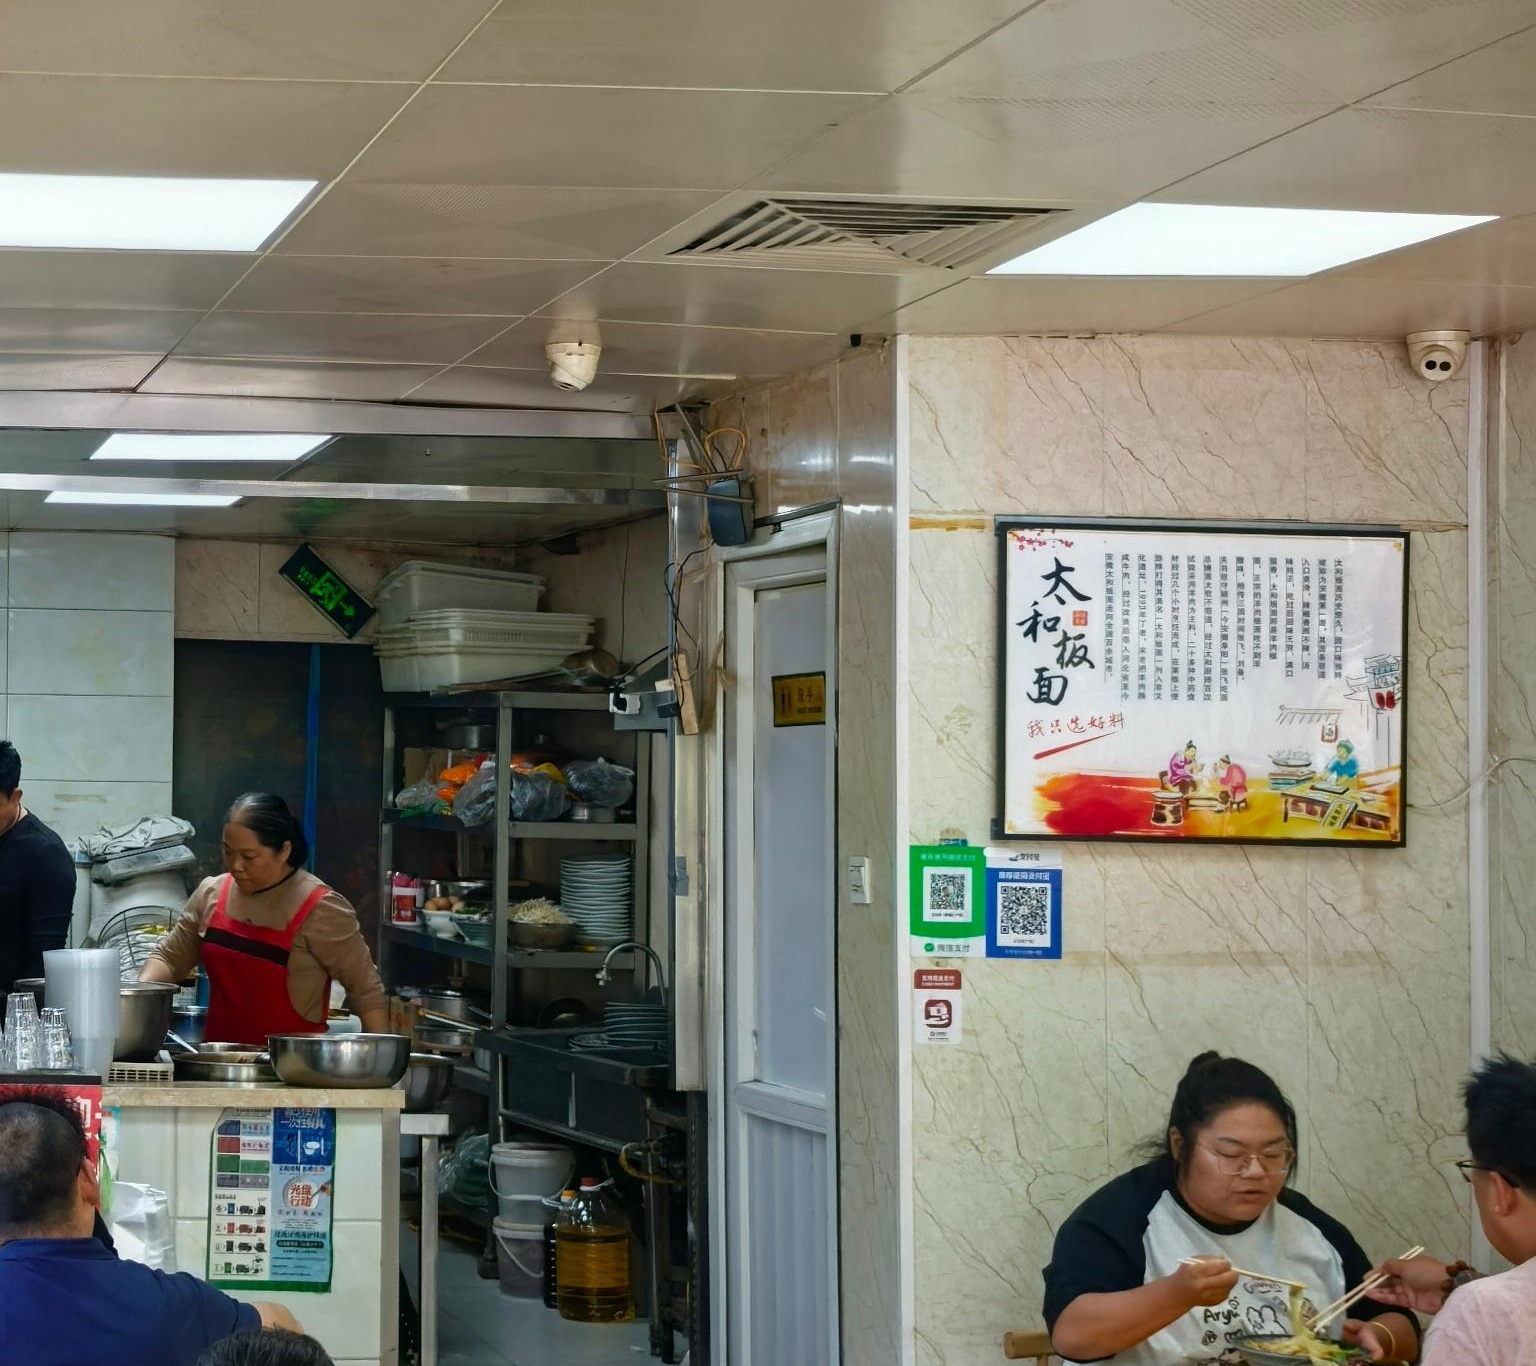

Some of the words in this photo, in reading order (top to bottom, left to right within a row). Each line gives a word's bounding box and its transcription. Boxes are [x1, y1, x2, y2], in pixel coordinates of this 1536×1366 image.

[1016, 556, 1095, 706] 太和板面
[1027, 712, 1125, 739] 我只选好料
[289, 1183, 312, 1195] 光盘
[291, 1195, 312, 1208] 行动
